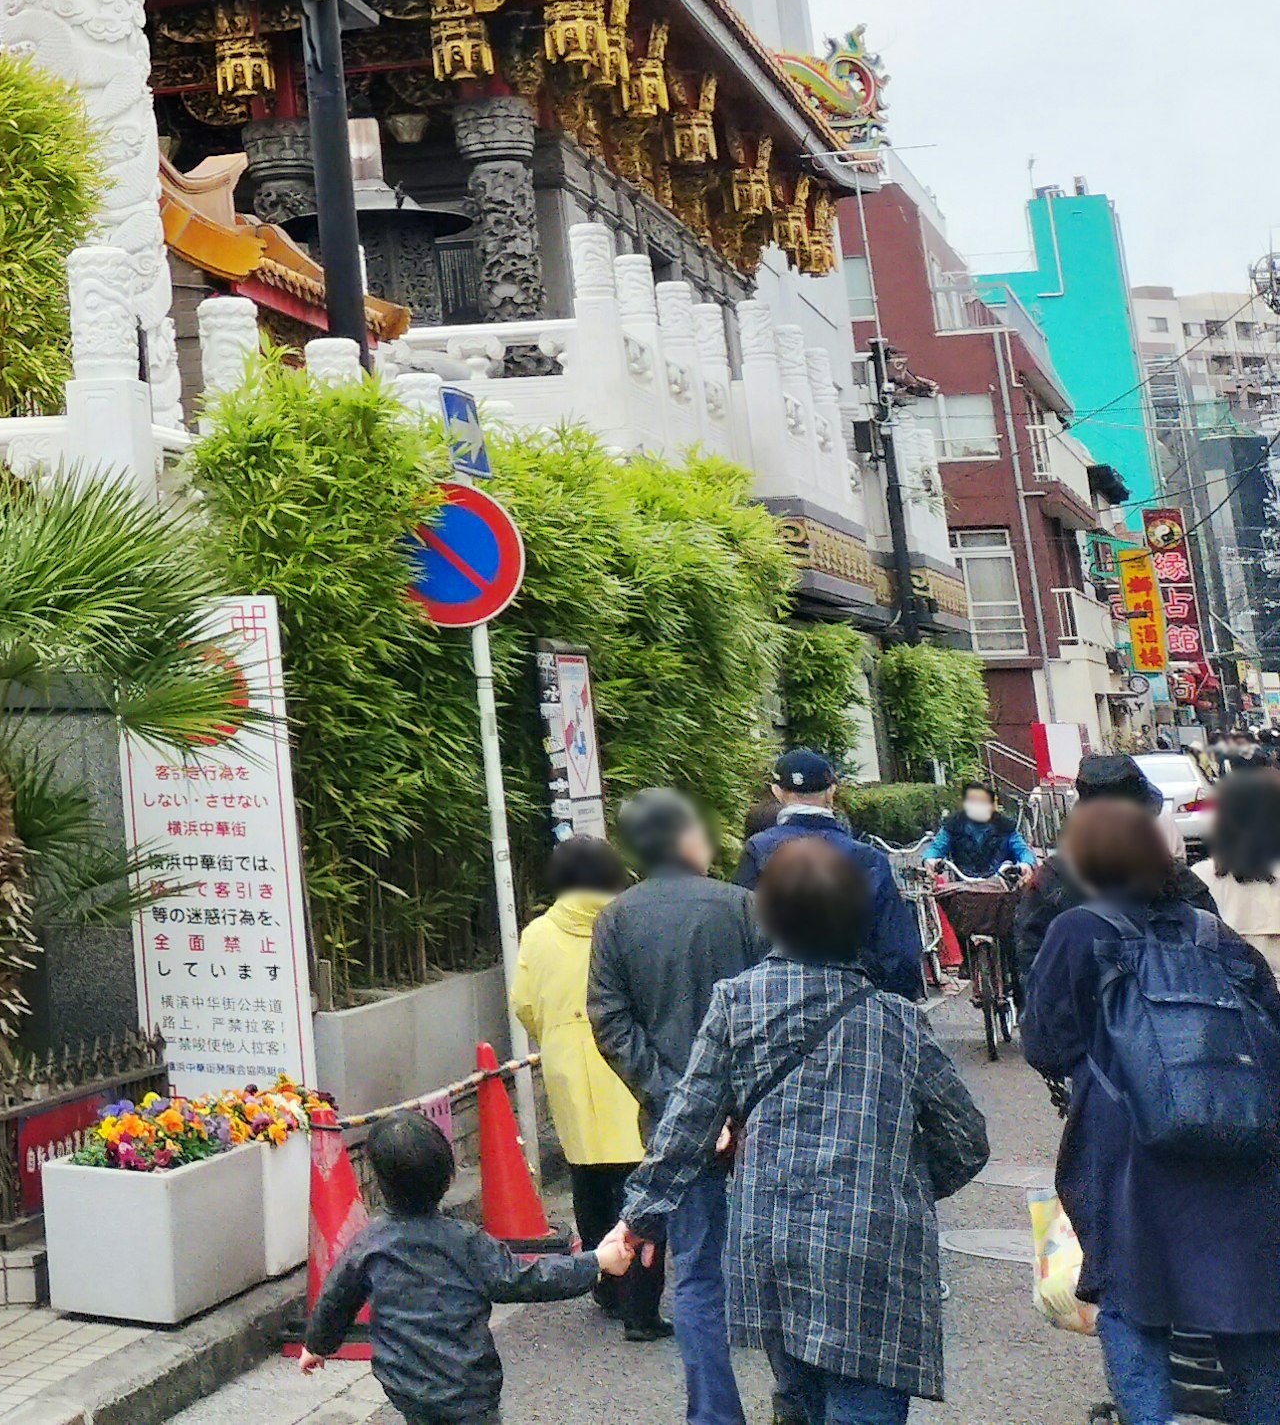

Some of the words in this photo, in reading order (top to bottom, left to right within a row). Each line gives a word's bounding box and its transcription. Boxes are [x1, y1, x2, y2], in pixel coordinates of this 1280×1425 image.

[143, 792, 269, 809] しない・させない
[167, 820, 246, 837] 横浜中華街
[151, 906, 281, 927] 等の迷惑行為を、
